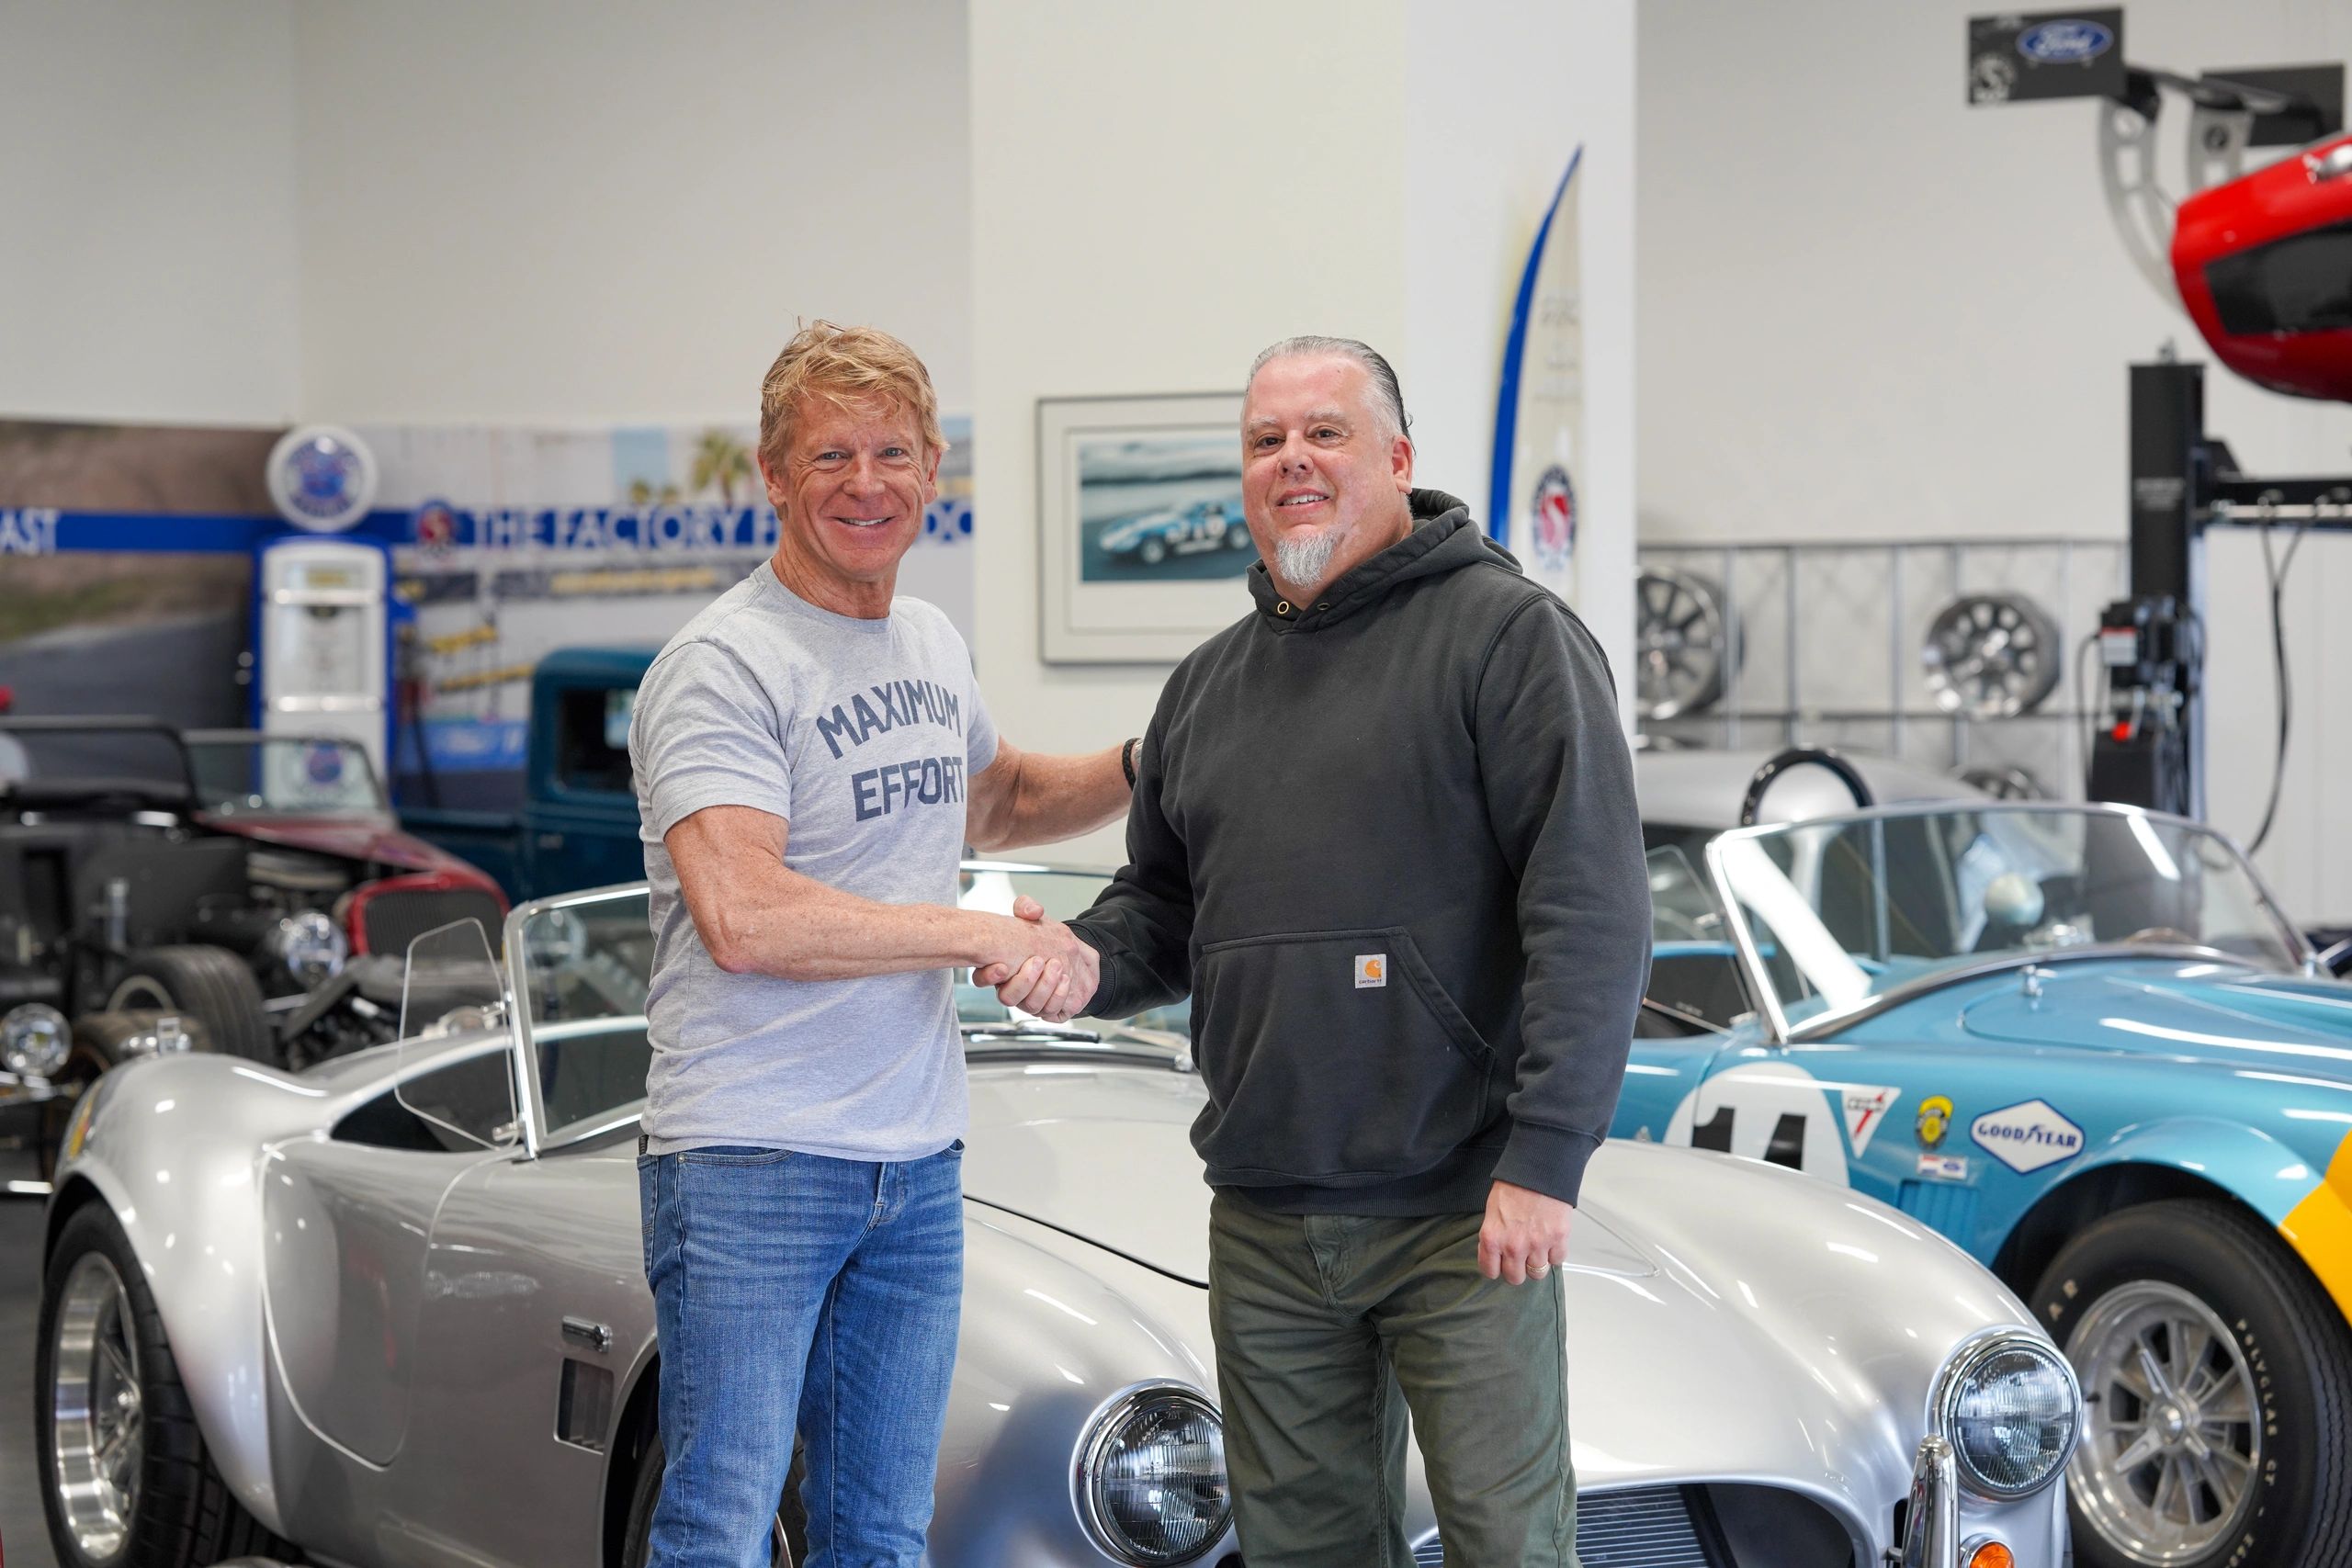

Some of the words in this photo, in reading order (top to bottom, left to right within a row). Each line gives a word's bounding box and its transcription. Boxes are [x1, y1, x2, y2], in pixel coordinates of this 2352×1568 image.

[468, 506, 548, 548] THE
[553, 504, 752, 548] FACTORY
[816, 679, 961, 760] MAXIMUM
[851, 757, 964, 822] EFFORT
